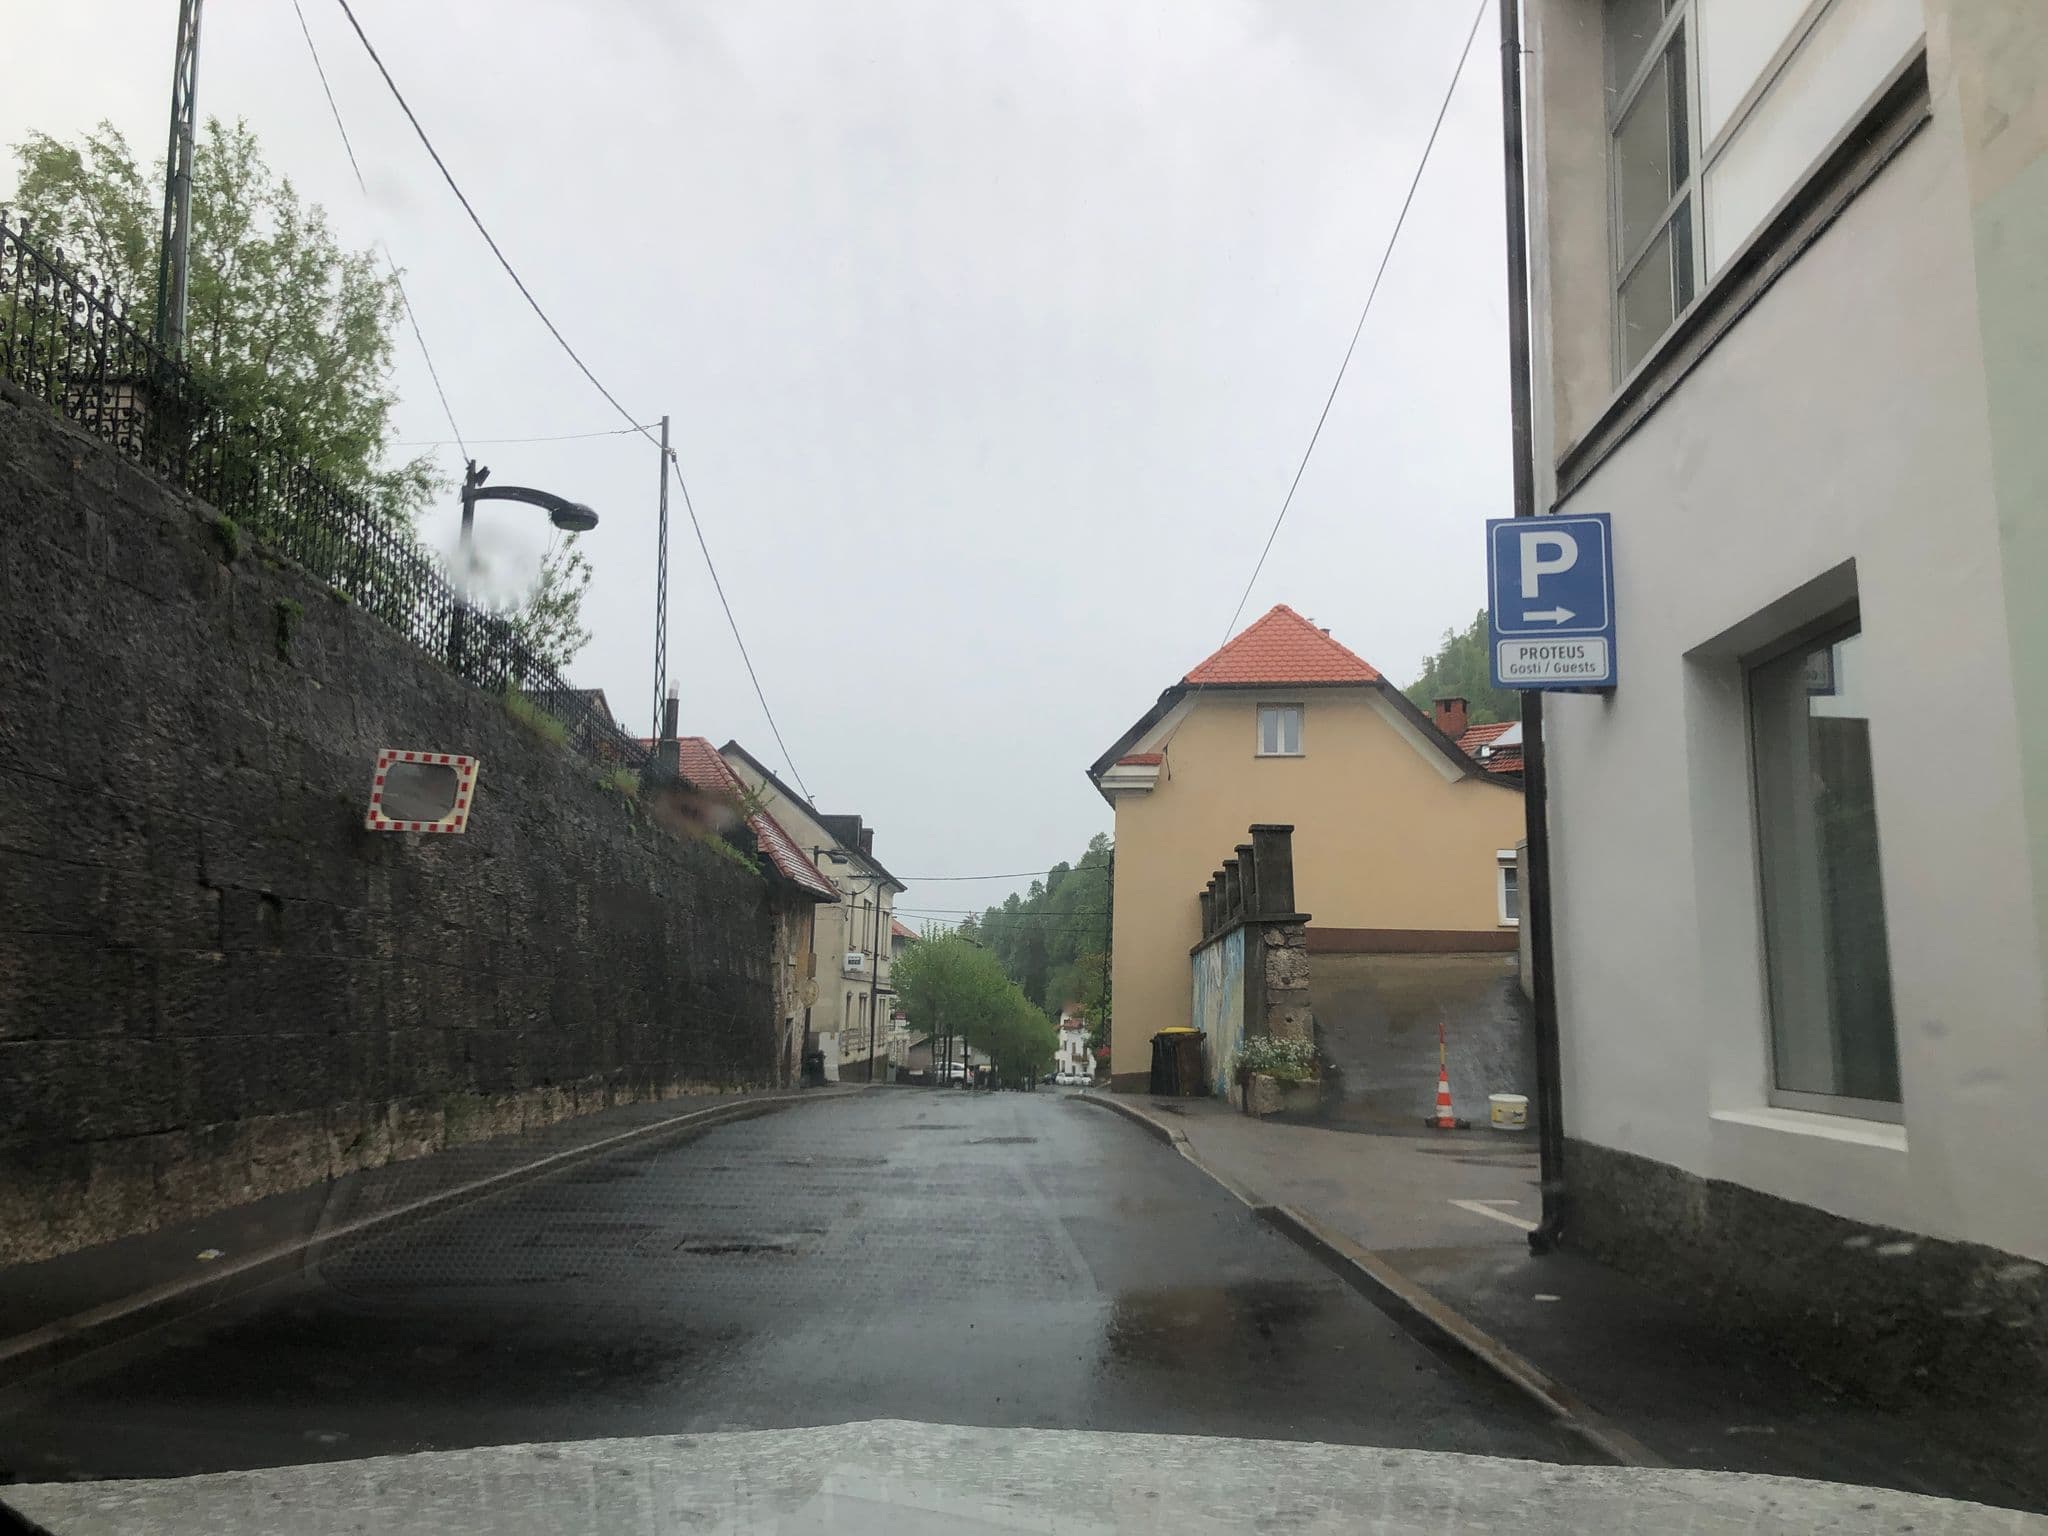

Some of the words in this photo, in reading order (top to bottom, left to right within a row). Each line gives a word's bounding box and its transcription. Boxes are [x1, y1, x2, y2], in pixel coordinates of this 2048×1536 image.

[1519, 530, 1579, 599] P
[1519, 645, 1585, 660] PROTEUS
[1510, 662, 1541, 675] Gosti
[1545, 661, 1551, 673] /
[1553, 661, 1596, 673] Guests
